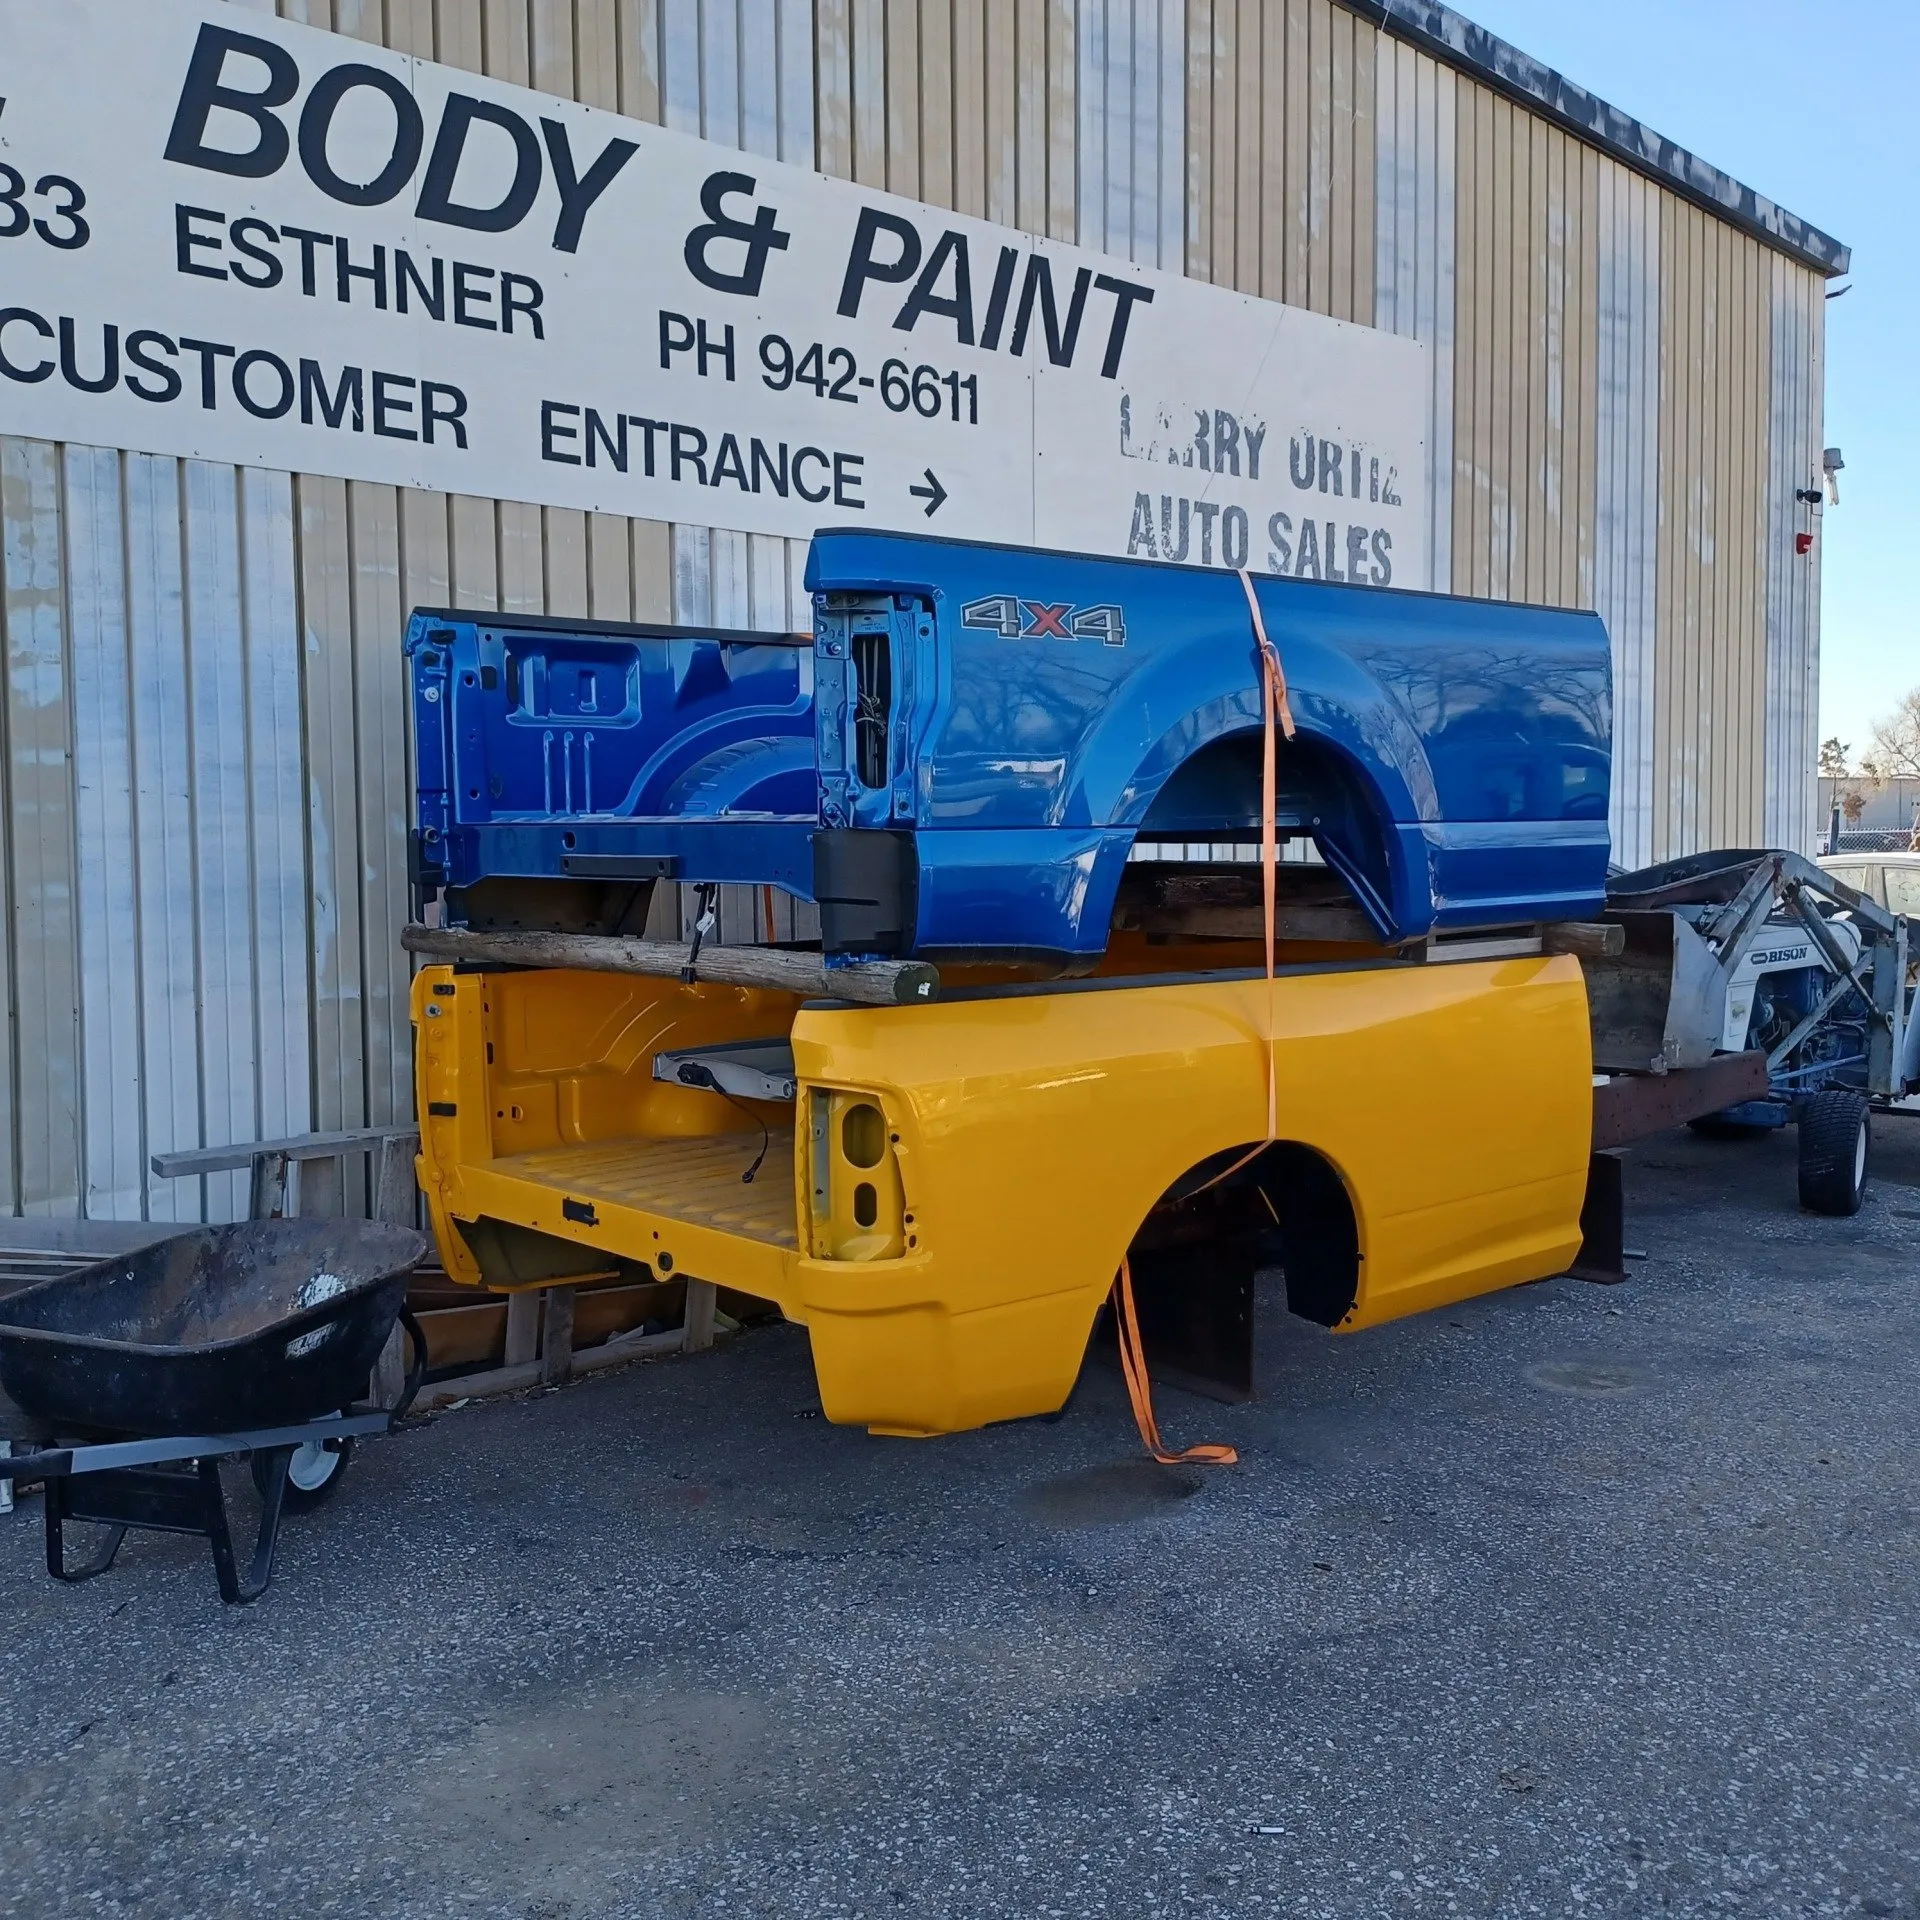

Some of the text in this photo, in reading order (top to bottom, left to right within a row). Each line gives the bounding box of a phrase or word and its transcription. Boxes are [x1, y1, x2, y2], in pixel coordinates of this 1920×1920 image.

[163, 21, 1155, 380] BODY & PAINT
[175, 202, 545, 341] ESTHNER
[0, 307, 865, 510] CUSTOMER ENTRANCE
[659, 309, 979, 425] PH 942-6611
[1120, 393, 1267, 480] LRRY
[1127, 491, 1393, 588] AUTO SALES
[1768, 947, 1808, 963] BISON
